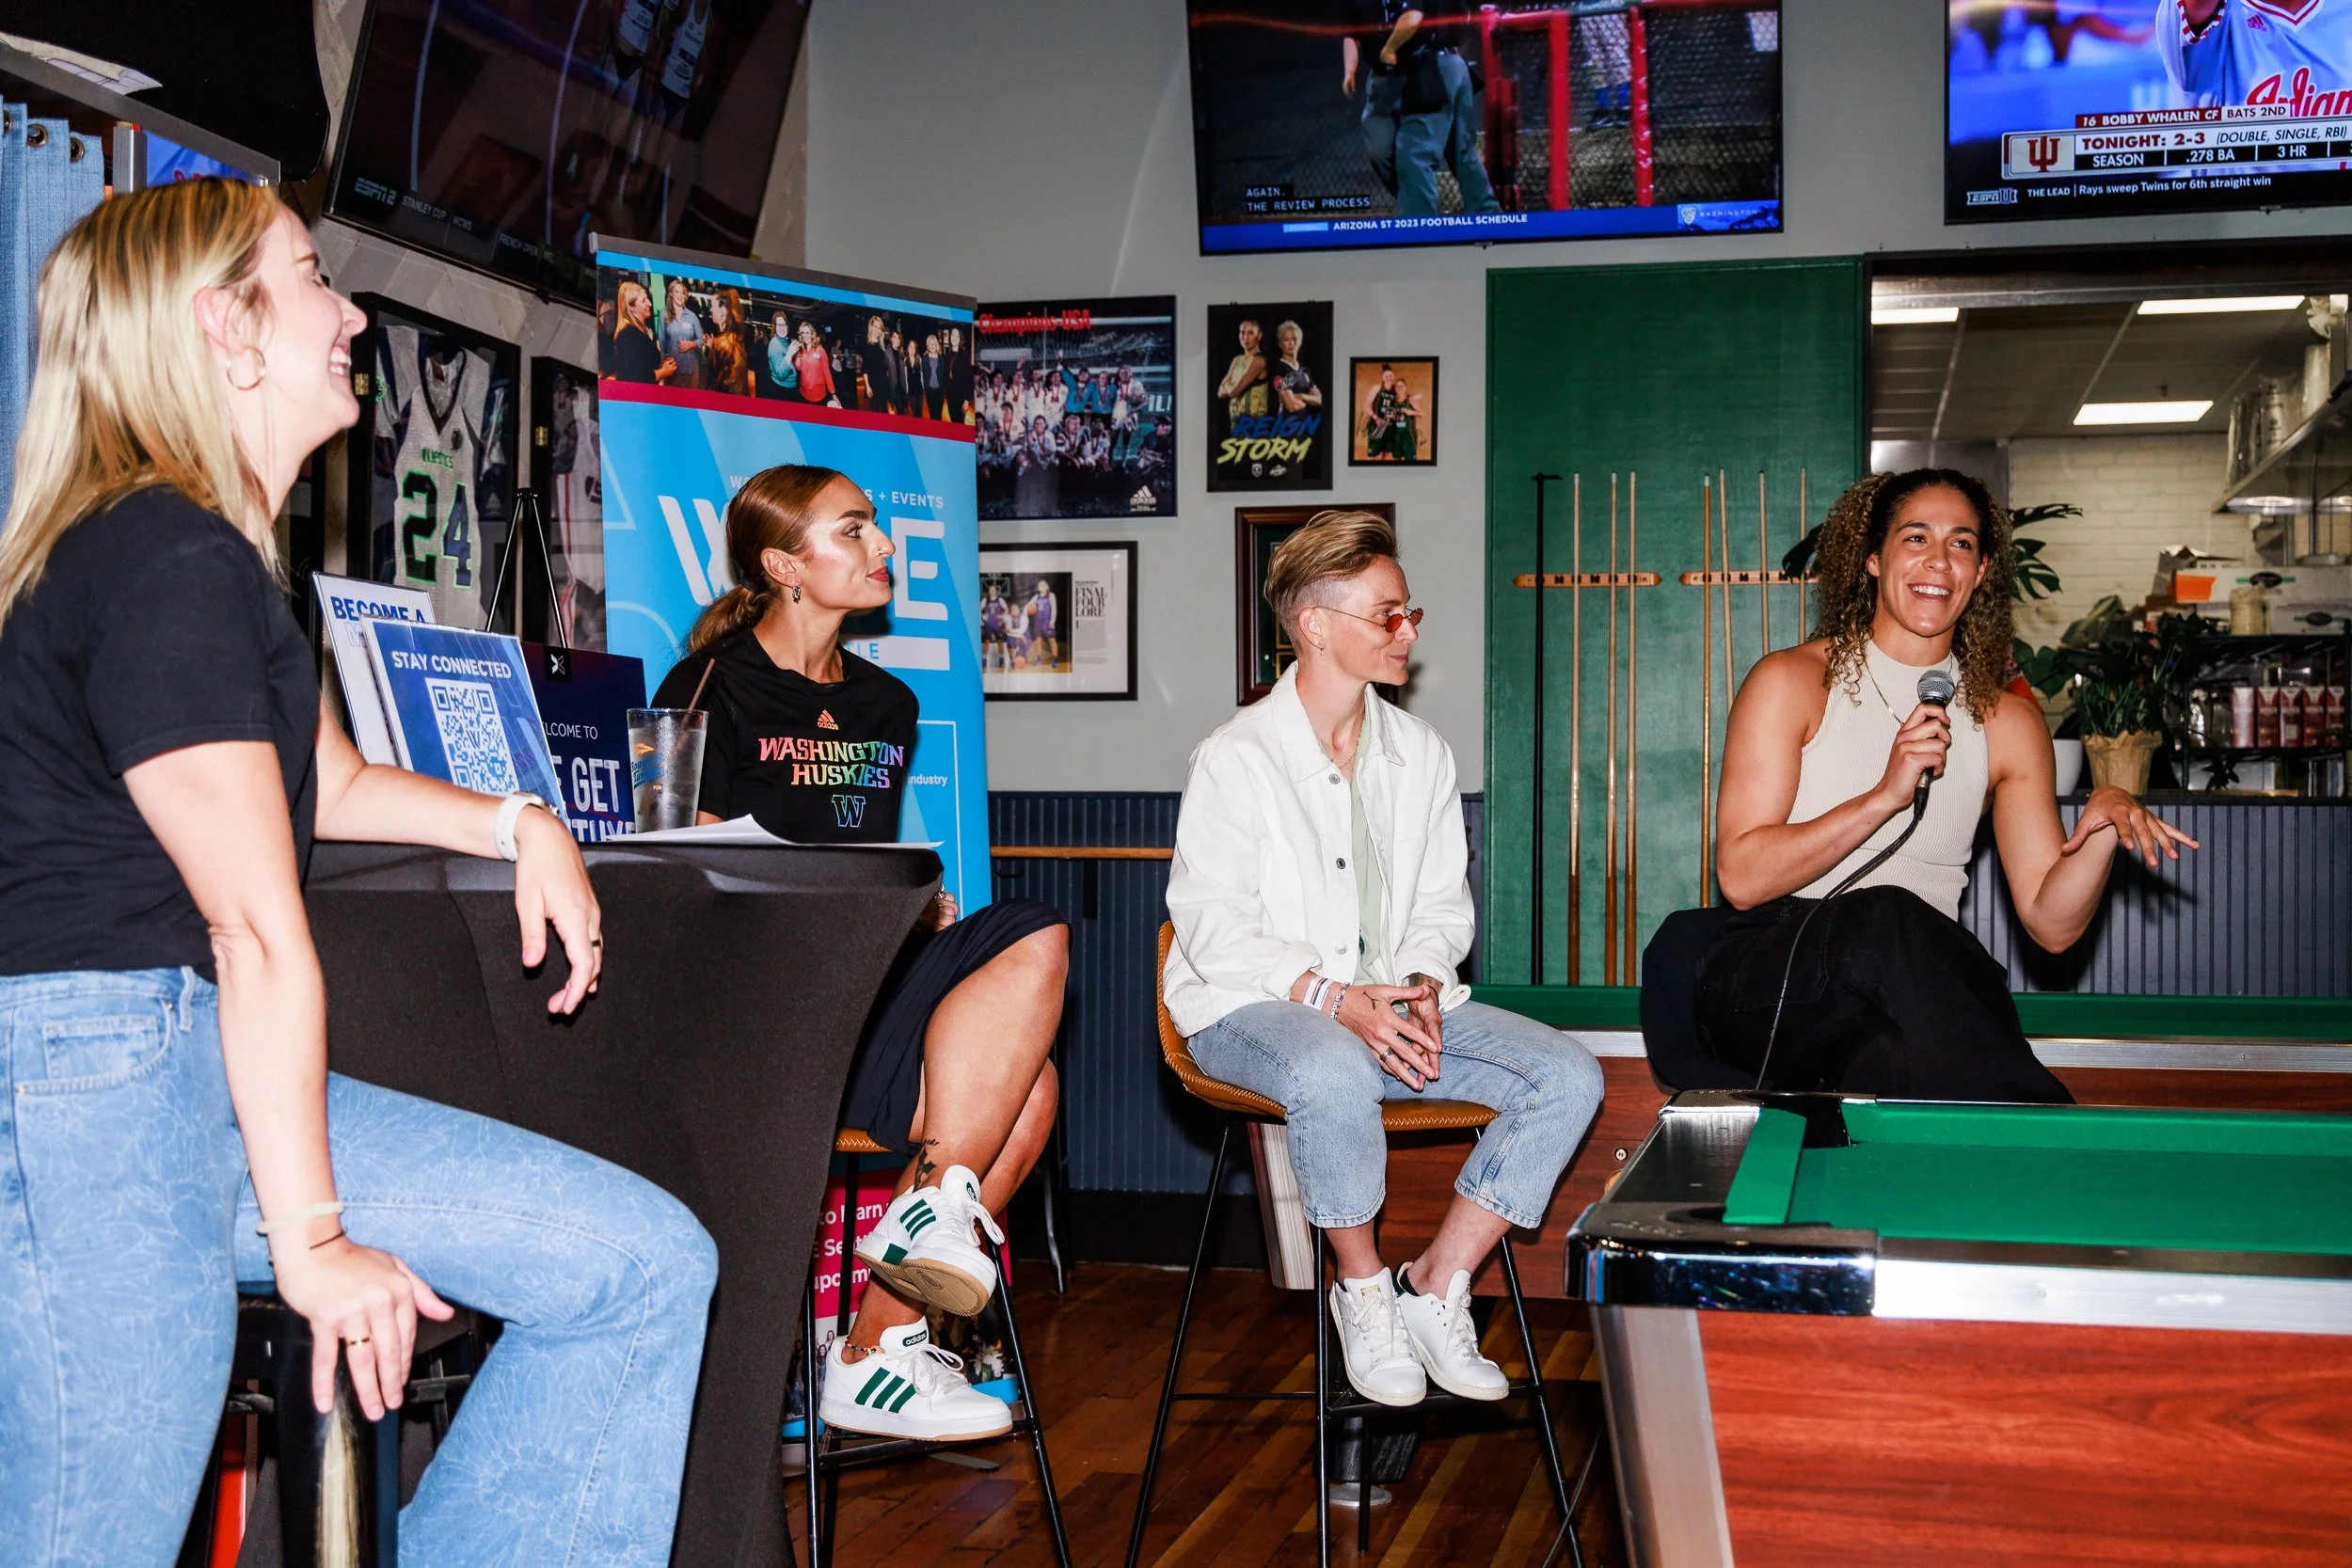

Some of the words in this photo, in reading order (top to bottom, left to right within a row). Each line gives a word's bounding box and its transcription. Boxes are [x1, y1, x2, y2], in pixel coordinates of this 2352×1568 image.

[2082, 116, 2097, 127] 16
[2102, 113, 2144, 126] BOBBY
[2146, 110, 2201, 123] WHALEN
[2204, 109, 2219, 120] CF
[2227, 107, 2256, 119] BATS
[2260, 106, 2286, 117] 2ND
[2082, 134, 2166, 150] TONIGHT:
[2174, 132, 2206, 146] 2-3
[2217, 130, 2270, 146] (DOUBLE,
[2275, 127, 2321, 141] SINGLE,
[2325, 125, 2347, 139] RBI)
[2092, 152, 2144, 167] SEASON
[2185, 150, 2214, 164] .278
[2217, 148, 2235, 161] BA
[2277, 145, 2286, 158] 3
[2289, 144, 2307, 157] HR
[1246, 187, 1286, 198] AGAIN.
[2026, 188, 2045, 198] THE
[2046, 187, 2071, 198] LEAD
[2079, 183, 2104, 198] Rays
[2106, 182, 2138, 195] sweep
[2140, 180, 2169, 192] Twins
[2171, 179, 2187, 190] for
[2189, 178, 2208, 189] 6th
[2210, 176, 2251, 189] straight
[2252, 175, 2272, 186] win
[402, 194, 433, 216] STANLEY
[1248, 201, 1267, 213] THE
[1274, 199, 1315, 211] REVIEW
[1322, 197, 1371, 209] PROCESS
[1333, 220, 1378, 231] ARIZONA
[1380, 219, 1392, 230] ST
[1394, 218, 1418, 229] 2023
[1421, 216, 1473, 228] FOOTBALL
[1475, 214, 1528, 225] SCHEDULE
[978, 310, 1058, 336] Champions
[1061, 309, 1091, 331] USA
[1232, 413, 1323, 438] REIGN
[1216, 436, 1313, 466] STORM
[892, 490, 945, 509] EVENTS
[402, 469, 472, 589] 24
[1075, 586, 1107, 596] FINAL
[1075, 597, 1105, 608] FOUR
[1075, 607, 1105, 617] LORE
[391, 650, 428, 671] STAY
[431, 655, 512, 679] CONNECTED
[584, 726, 598, 740] TO
[817, 721, 839, 731] adidas
[758, 736, 905, 768] WASHINGTON
[571, 756, 621, 814] GET
[791, 763, 892, 789] HUSKIES
[907, 773, 948, 788] industry
[832, 794, 866, 829] W
[905, 1331, 928, 1345] adidas
